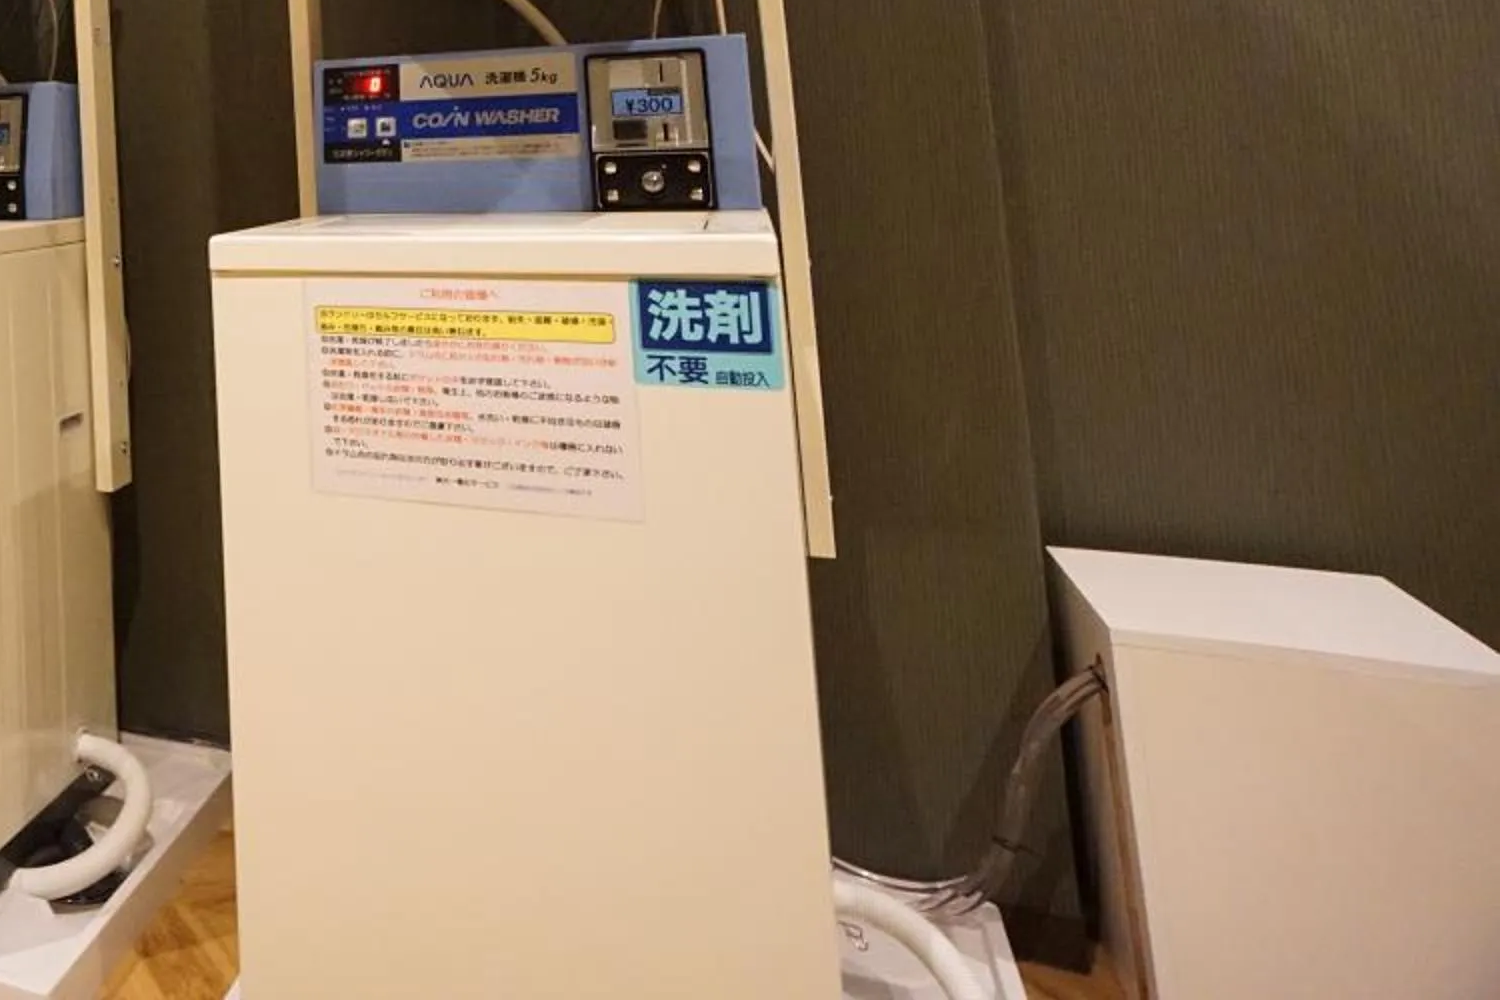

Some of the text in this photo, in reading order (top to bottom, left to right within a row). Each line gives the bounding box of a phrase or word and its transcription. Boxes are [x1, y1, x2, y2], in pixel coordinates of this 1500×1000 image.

[419, 67, 558, 89] AQUA 洗濯機 5kg
[474, 107, 561, 127] WASHER
[625, 98, 674, 115] ¥300
[647, 288, 763, 344] 洗剤
[646, 354, 709, 385] 不要
[715, 369, 771, 388] 自動投入
